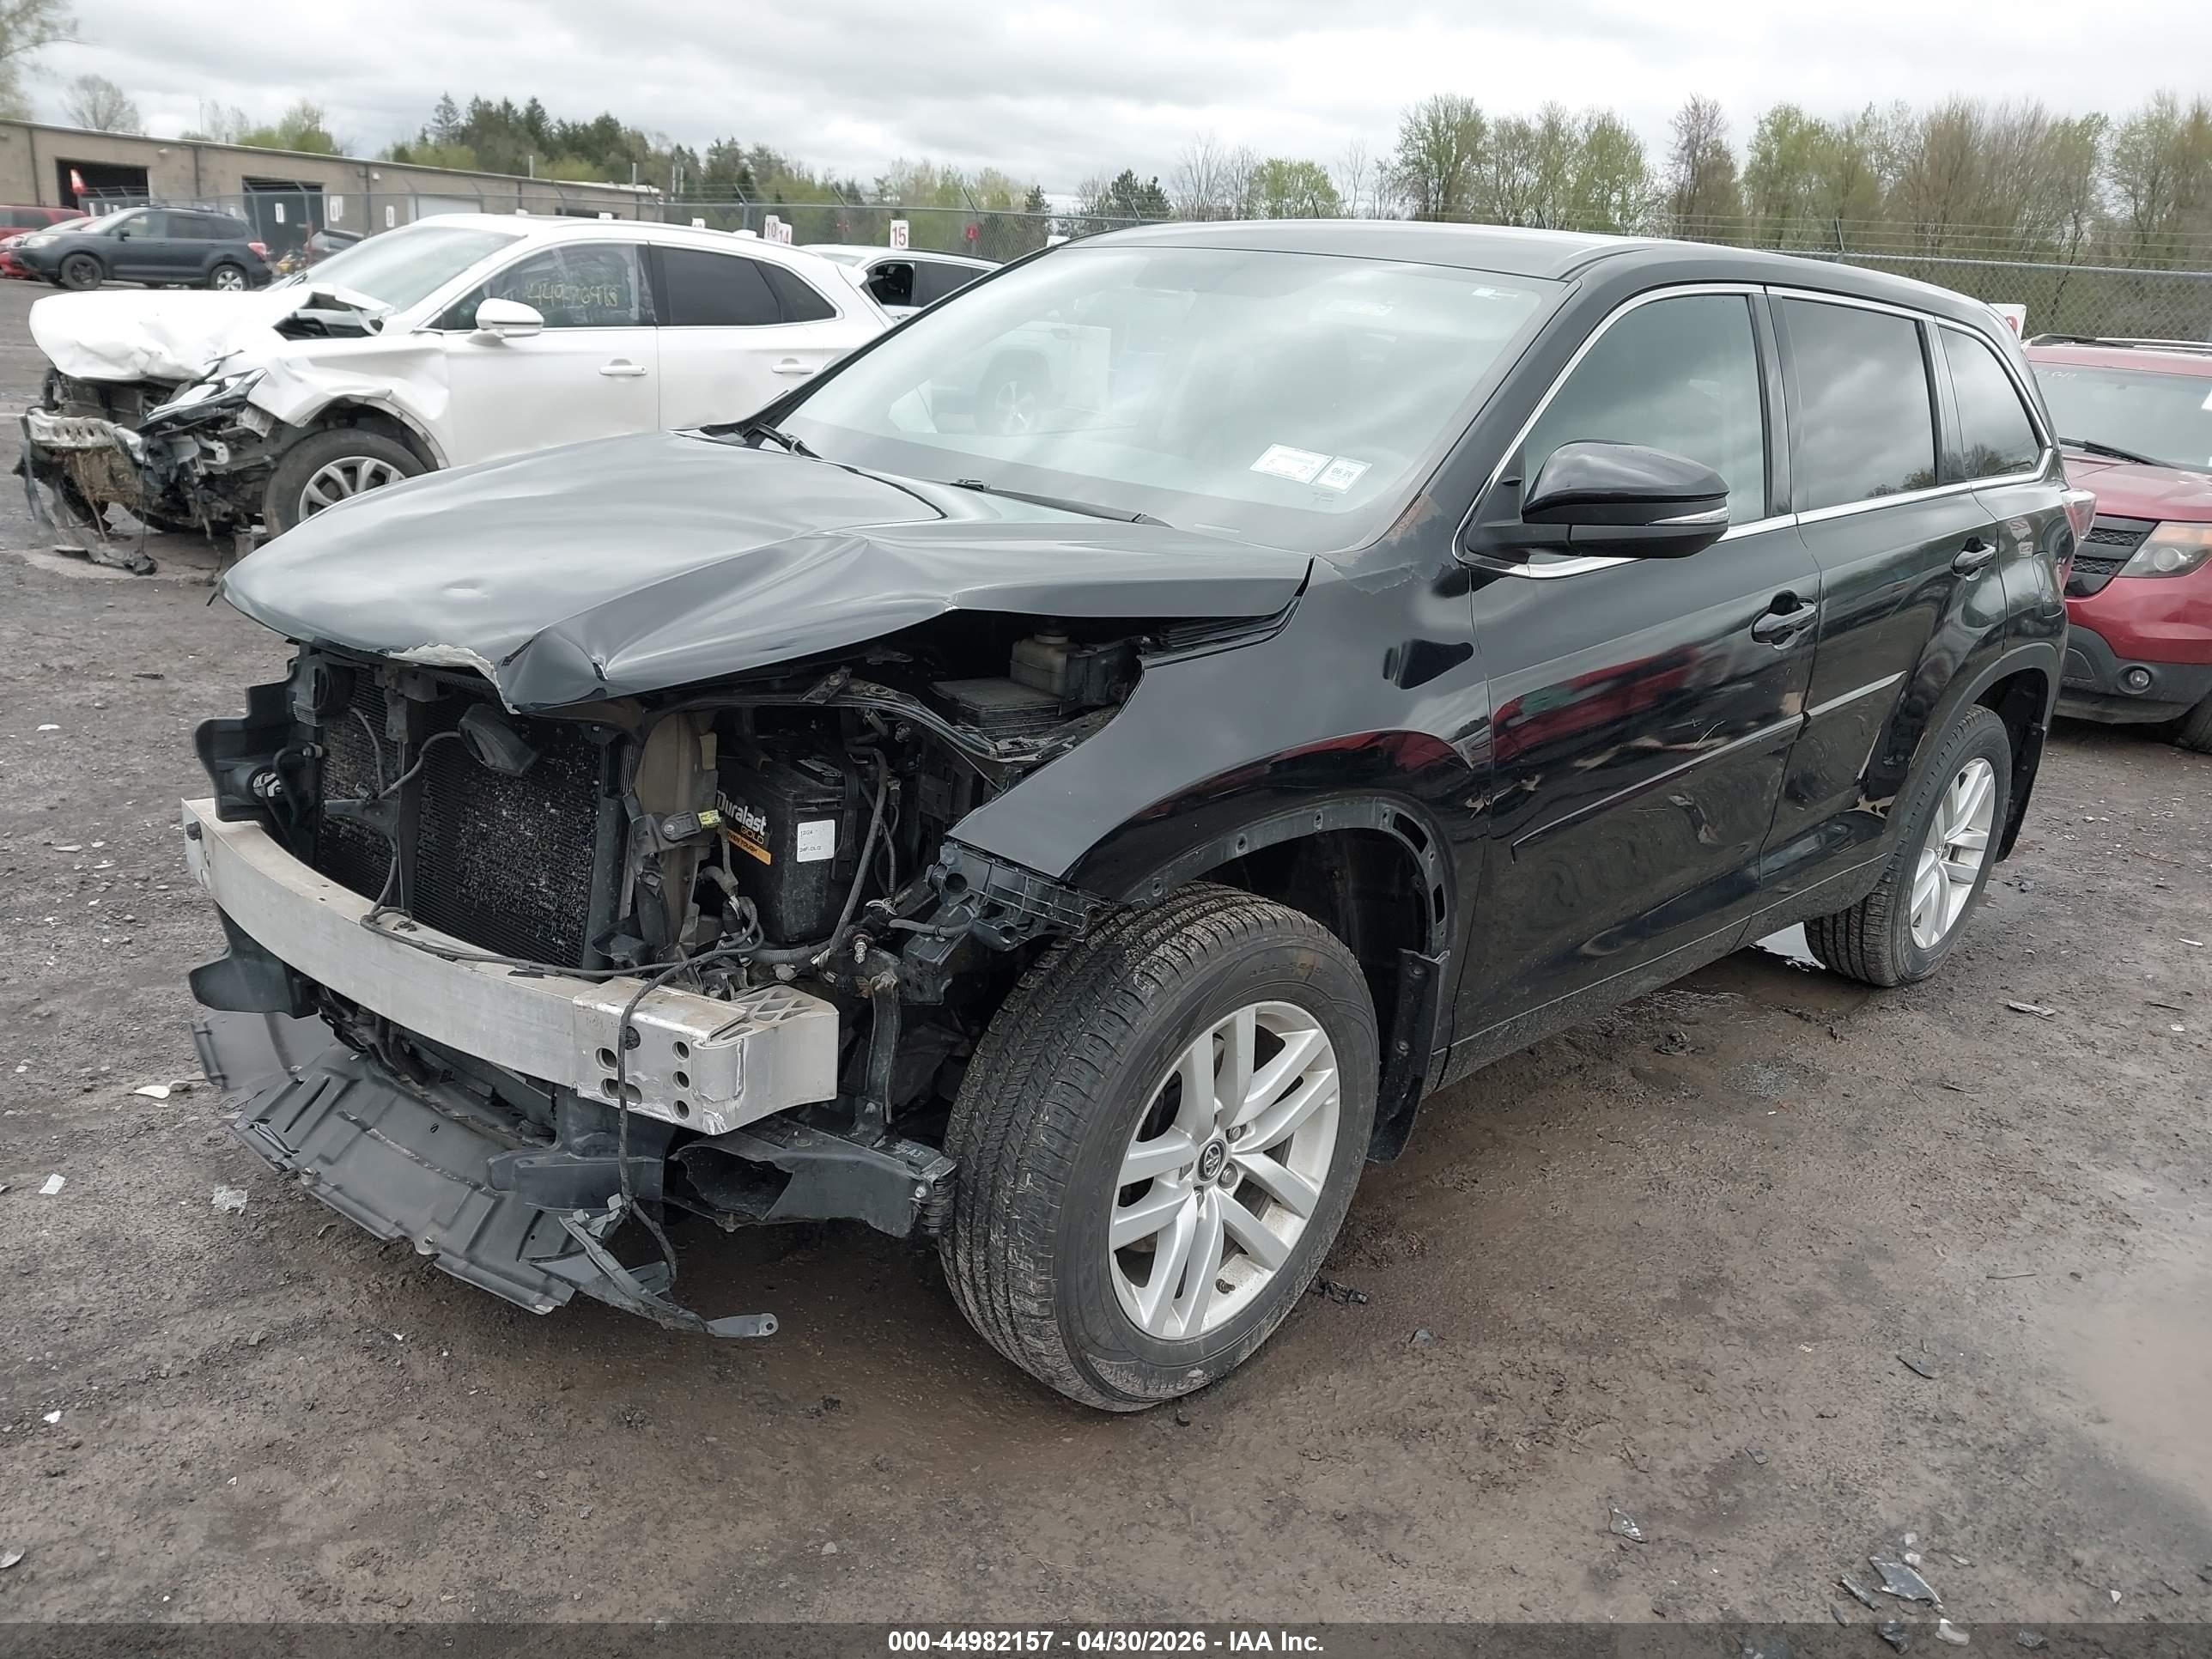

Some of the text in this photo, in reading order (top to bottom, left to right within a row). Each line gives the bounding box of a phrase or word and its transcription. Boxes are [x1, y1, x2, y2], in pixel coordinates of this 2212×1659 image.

[892, 226, 907, 246] 15
[716, 789, 767, 836] Duralast
[740, 825, 764, 845] GOLD
